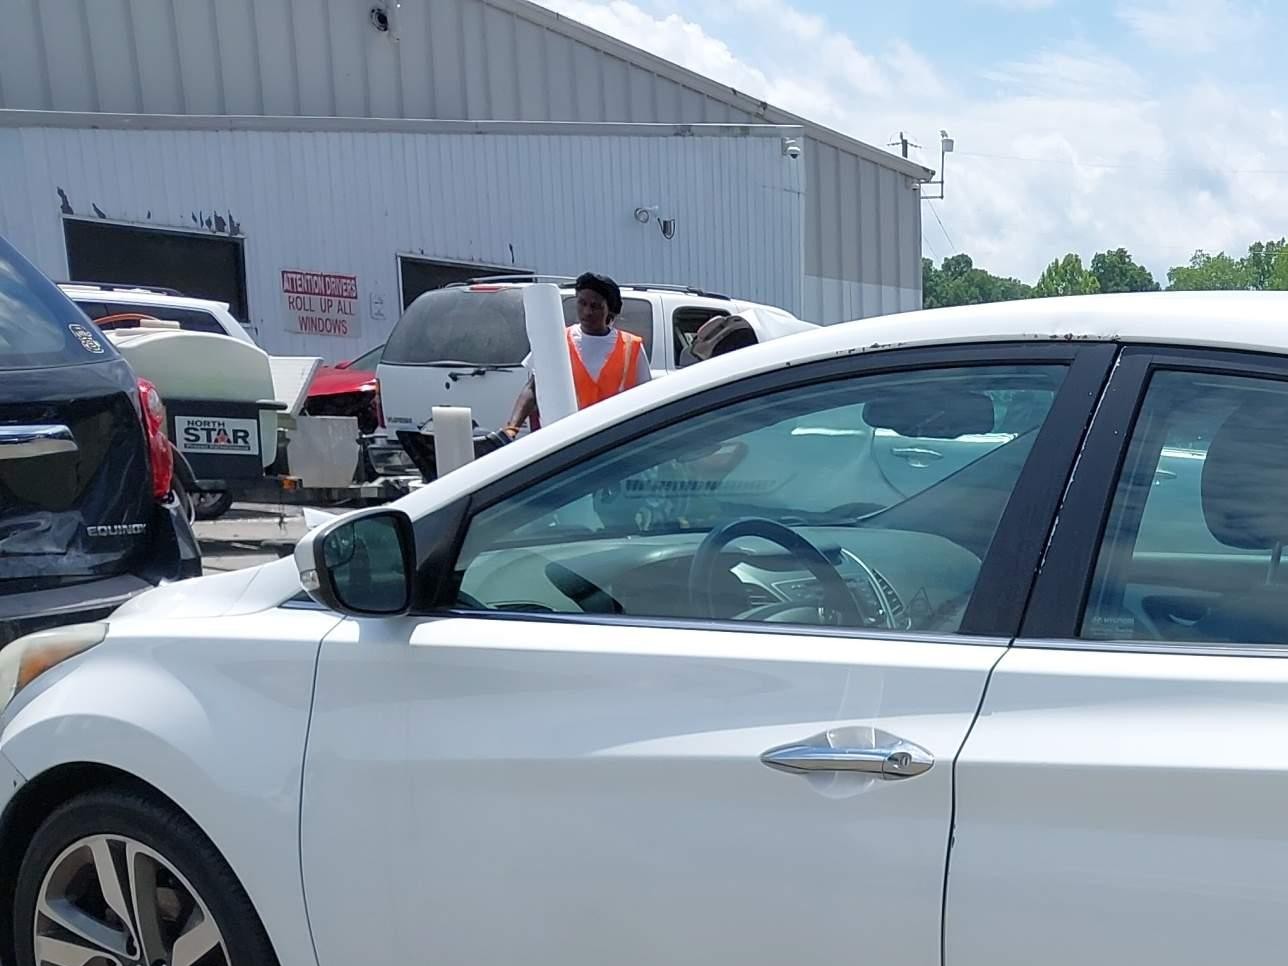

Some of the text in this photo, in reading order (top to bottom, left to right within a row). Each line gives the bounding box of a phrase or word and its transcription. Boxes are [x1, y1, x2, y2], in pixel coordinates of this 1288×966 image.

[284, 273, 356, 297] ATTENTION DRIVERS
[288, 295, 315, 312] ROLL
[320, 297, 333, 313] UP
[336, 299, 355, 315] ALL
[298, 315, 348, 335] WINDOWS
[187, 419, 225, 428] NORTH
[183, 427, 250, 444] STAR
